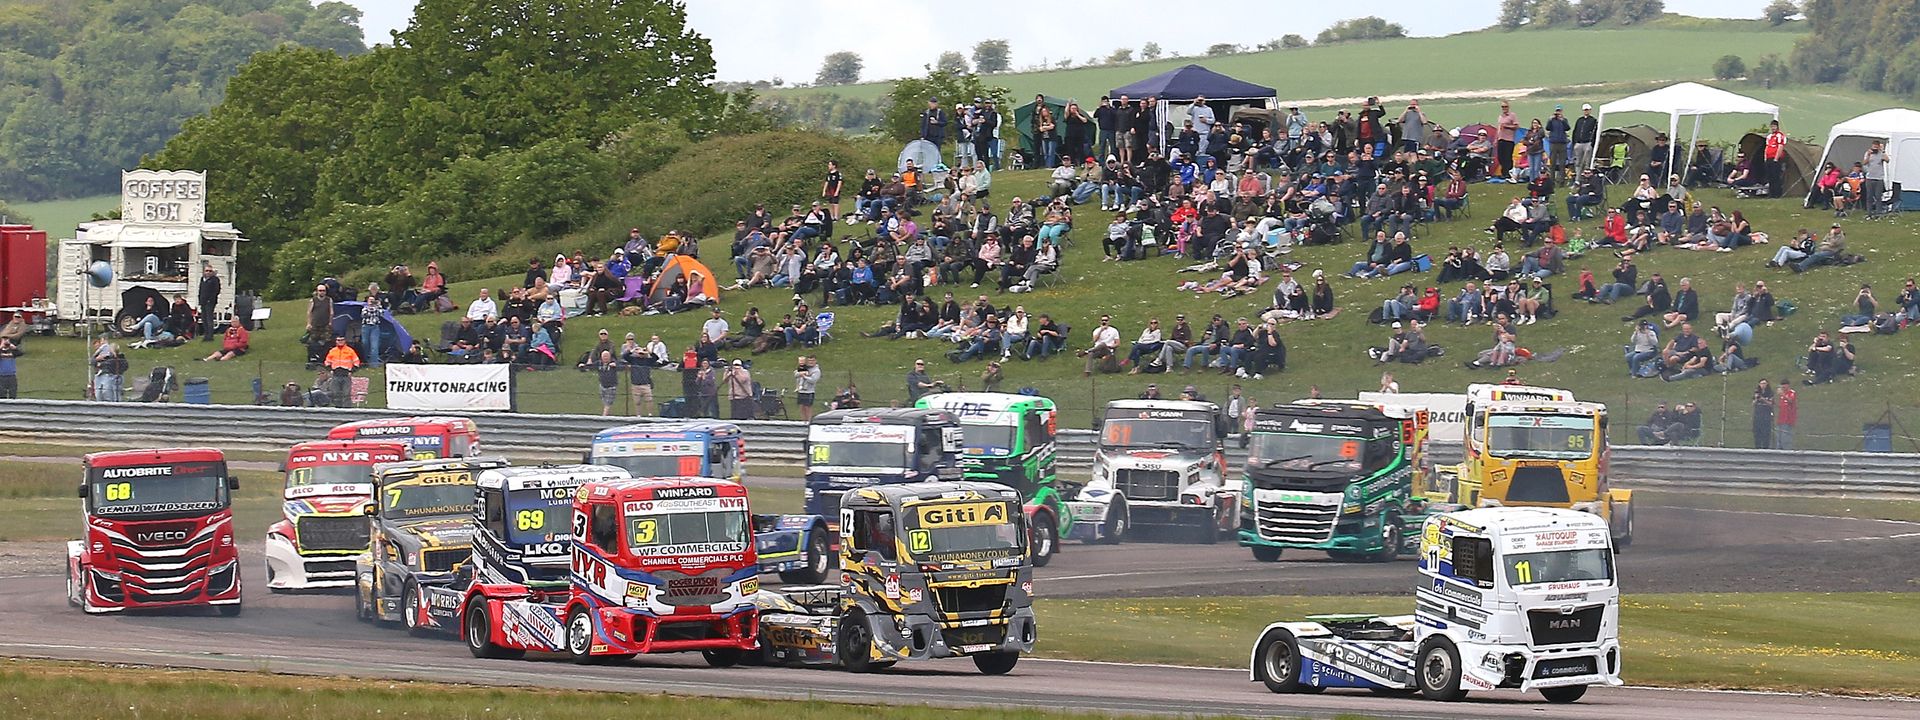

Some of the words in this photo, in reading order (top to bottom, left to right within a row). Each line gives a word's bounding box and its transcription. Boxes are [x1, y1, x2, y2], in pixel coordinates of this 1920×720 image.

[125, 180, 201, 199] COFFEE
[143, 203, 181, 221] BOX
[389, 381, 507, 393] THRUXTONRACING
[414, 437, 440, 445] NYR
[1109, 424, 1132, 445] 61
[1568, 435, 1584, 448] 95
[322, 452, 370, 462] NYR
[103, 467, 172, 478] AUTOBRITE
[423, 476, 451, 484] Giti
[106, 483, 131, 501] 68
[387, 489, 402, 508] 7
[97, 504, 140, 515] GEMINI
[142, 501, 223, 513] WINDSCREENS
[626, 502, 654, 512] ALCO
[720, 499, 744, 508] NYR
[518, 509, 544, 531] 69
[842, 512, 851, 534] 12
[924, 508, 976, 524] Giti
[574, 515, 586, 537] 3
[636, 520, 656, 543] 3
[138, 531, 186, 542] IVECO
[912, 533, 929, 549] 12
[1541, 531, 1577, 540] AUTOQUIP
[525, 543, 564, 555] LKQ
[639, 548, 657, 556] WP
[660, 543, 743, 555] COMMERCIALS
[928, 550, 1010, 562] TAHUNAHONEY.CO.UK
[572, 545, 607, 590] NYR
[642, 558, 677, 566] CHANNEL
[678, 555, 729, 565] COMMERCIALS
[730, 554, 743, 562] PLC
[1429, 551, 1437, 569] 11
[1515, 561, 1533, 583] 11
[629, 585, 645, 593] HGV
[743, 581, 757, 590] HGV
[1434, 583, 1443, 593] ds
[1444, 588, 1481, 606] commercials
[431, 592, 458, 609] MORRIS
[1549, 619, 1581, 629] MAN
